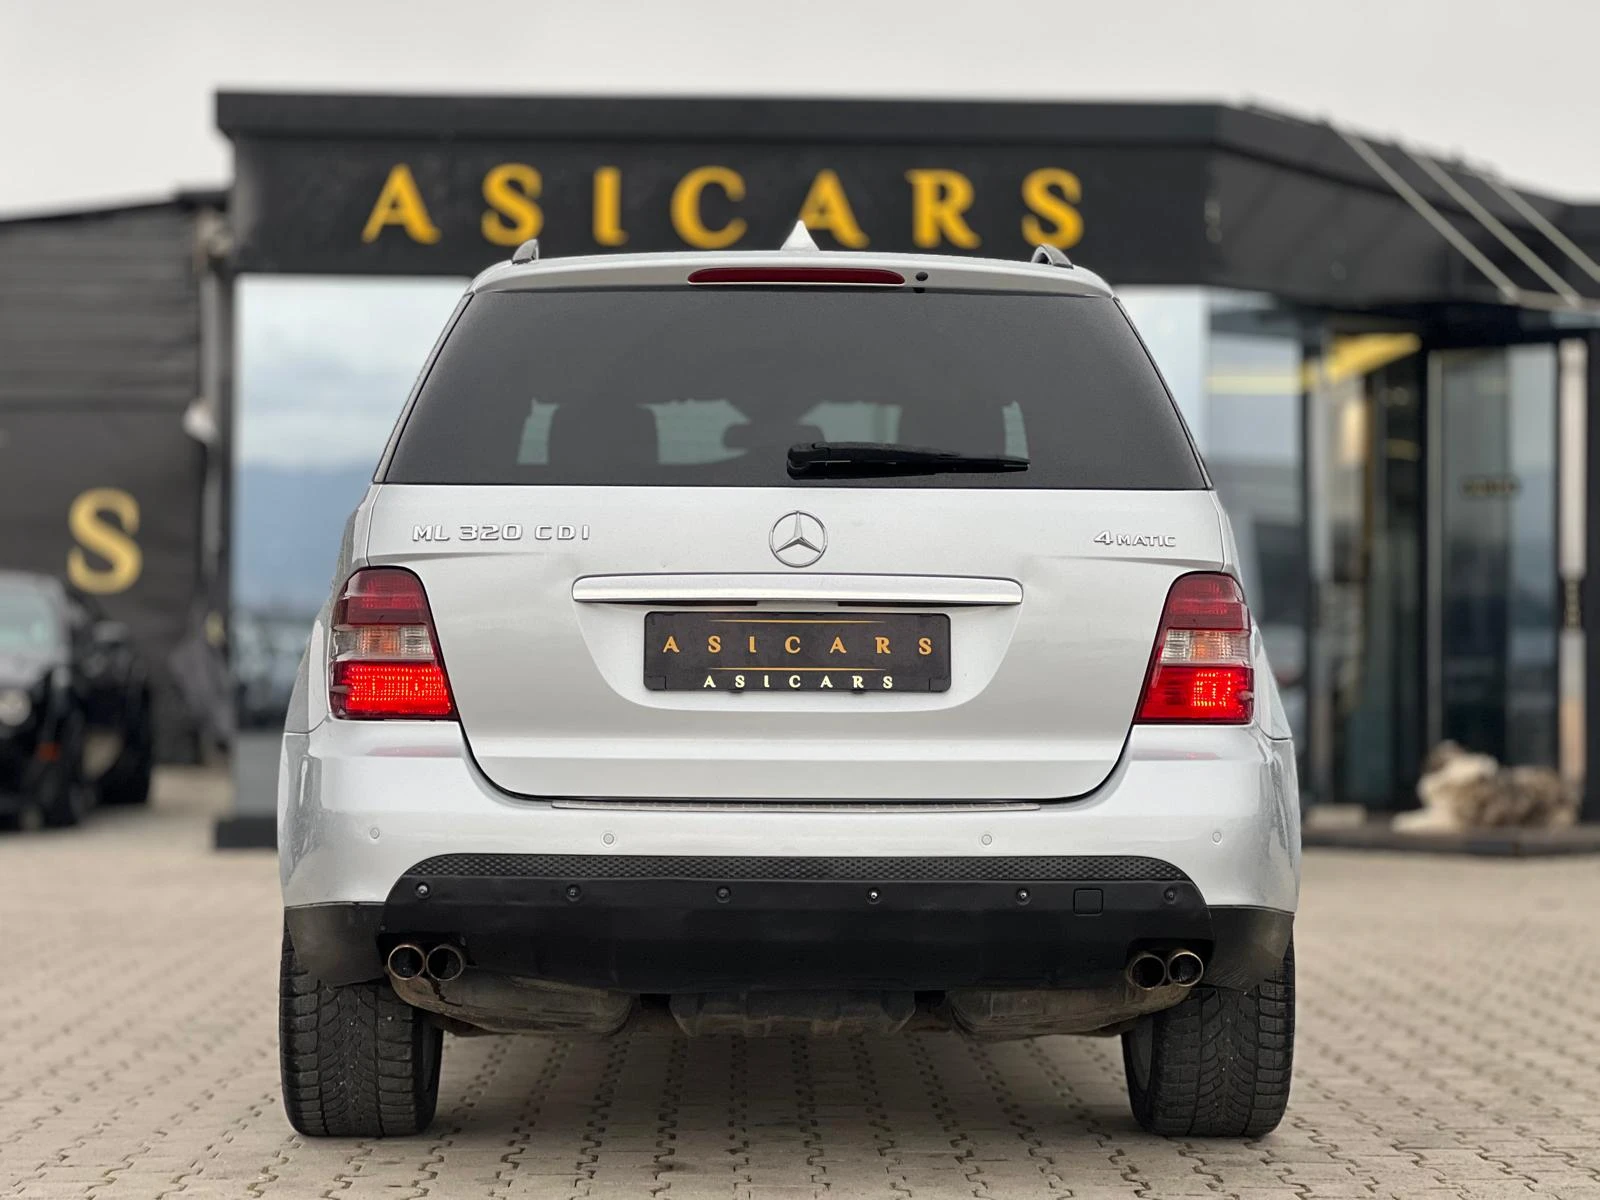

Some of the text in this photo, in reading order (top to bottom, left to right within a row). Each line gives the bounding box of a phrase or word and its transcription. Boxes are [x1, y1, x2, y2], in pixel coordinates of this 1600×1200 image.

[362, 163, 1083, 250] ASICARS
[67, 487, 142, 594] S
[412, 524, 591, 542] ML 320 CDI
[662, 635, 933, 656] ASICARS
[703, 674, 894, 690] ASICARS
